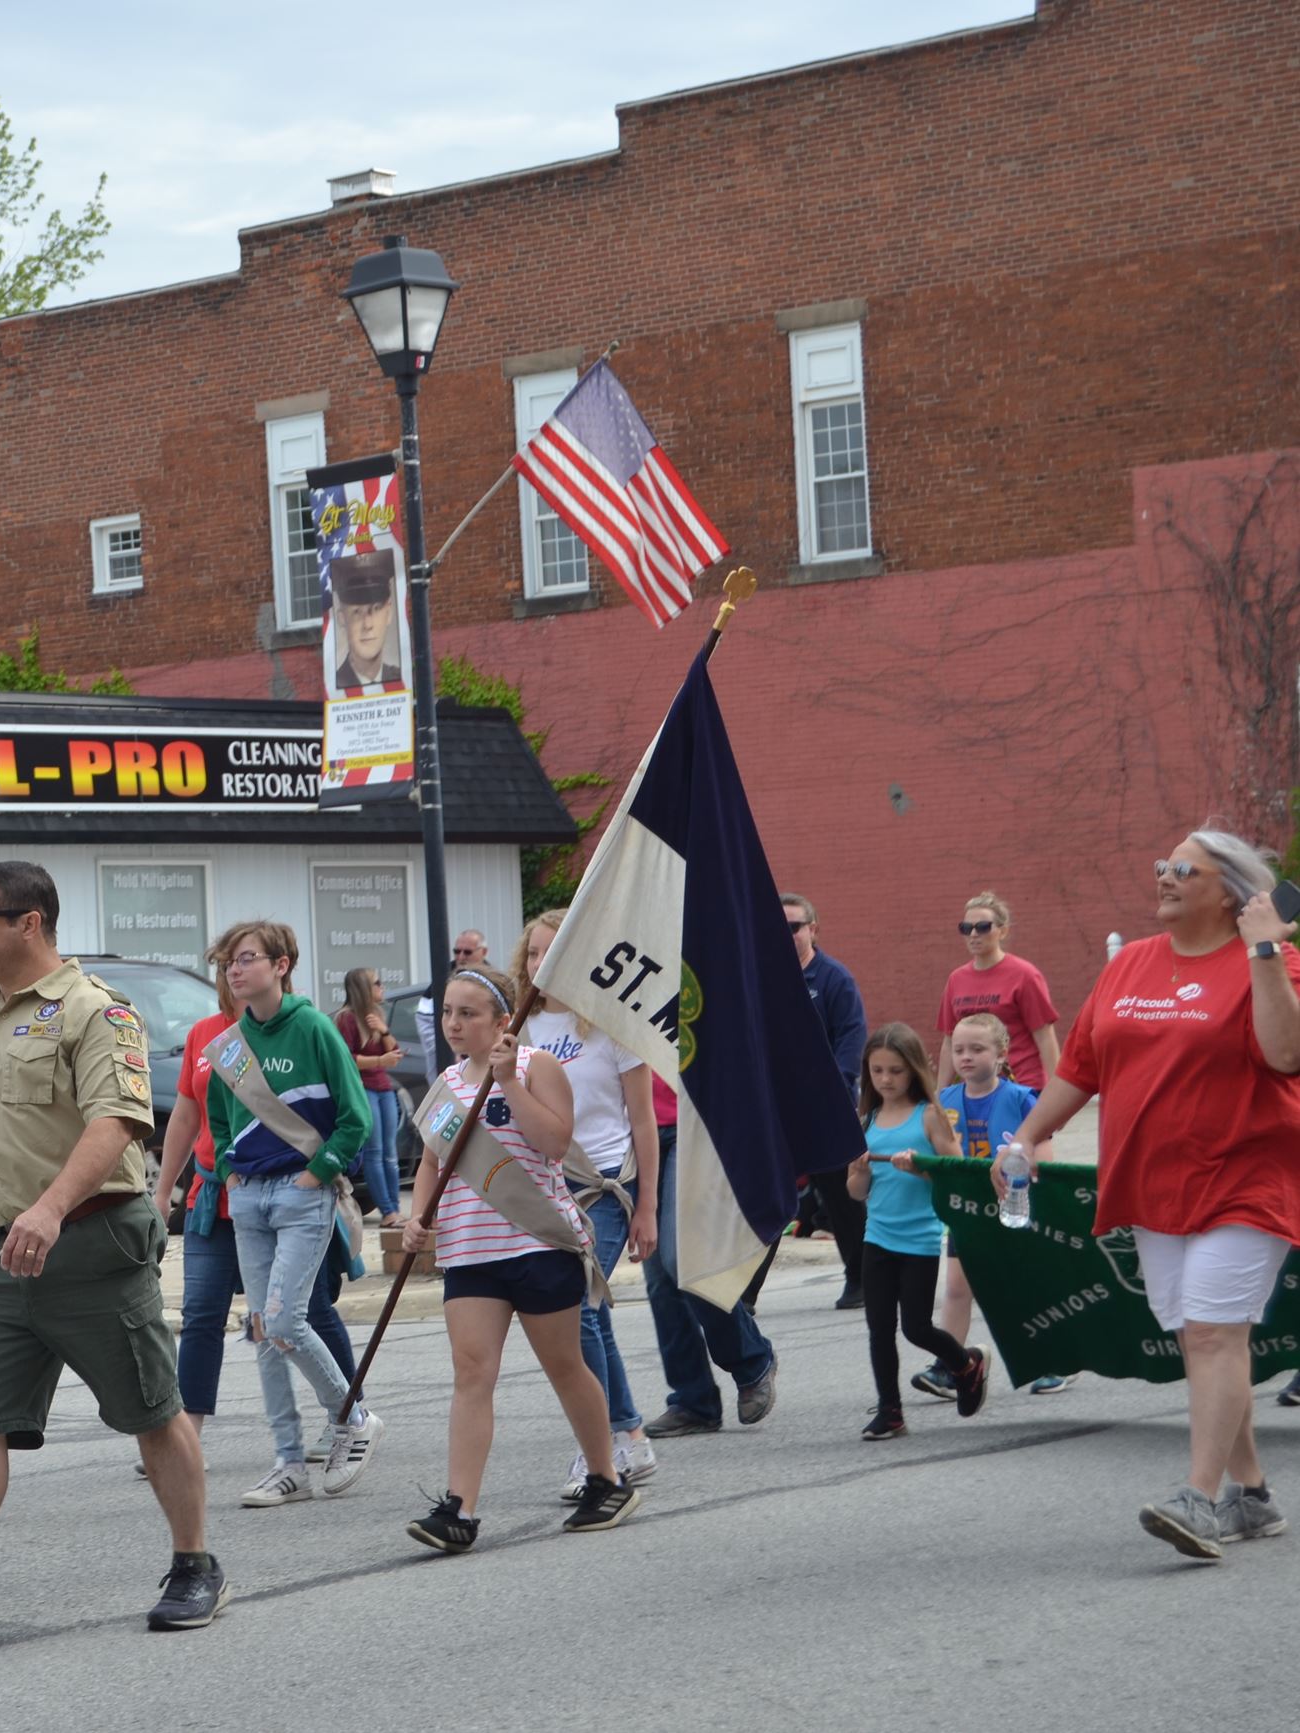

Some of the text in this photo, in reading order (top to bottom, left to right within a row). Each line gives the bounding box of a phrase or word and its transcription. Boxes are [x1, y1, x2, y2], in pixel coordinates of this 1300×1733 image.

[335, 710, 375, 724] KENNETH
[386, 706, 402, 717] DAY
[228, 741, 322, 767] CLEANING
[113, 872, 194, 891] Mold Mitigation
[374, 874, 404, 892] Office
[112, 912, 198, 929] Fire Restoration
[589, 941, 663, 1012] ST.
[1112, 995, 1176, 1010] girl scouts
[1117, 1008, 1209, 1021] of western ohio
[442, 1116, 462, 1140] 579
[949, 1193, 1084, 1250] BRONIES
[1022, 1283, 1110, 1339] JUNIORS
[1141, 1338, 1181, 1357] GIR
